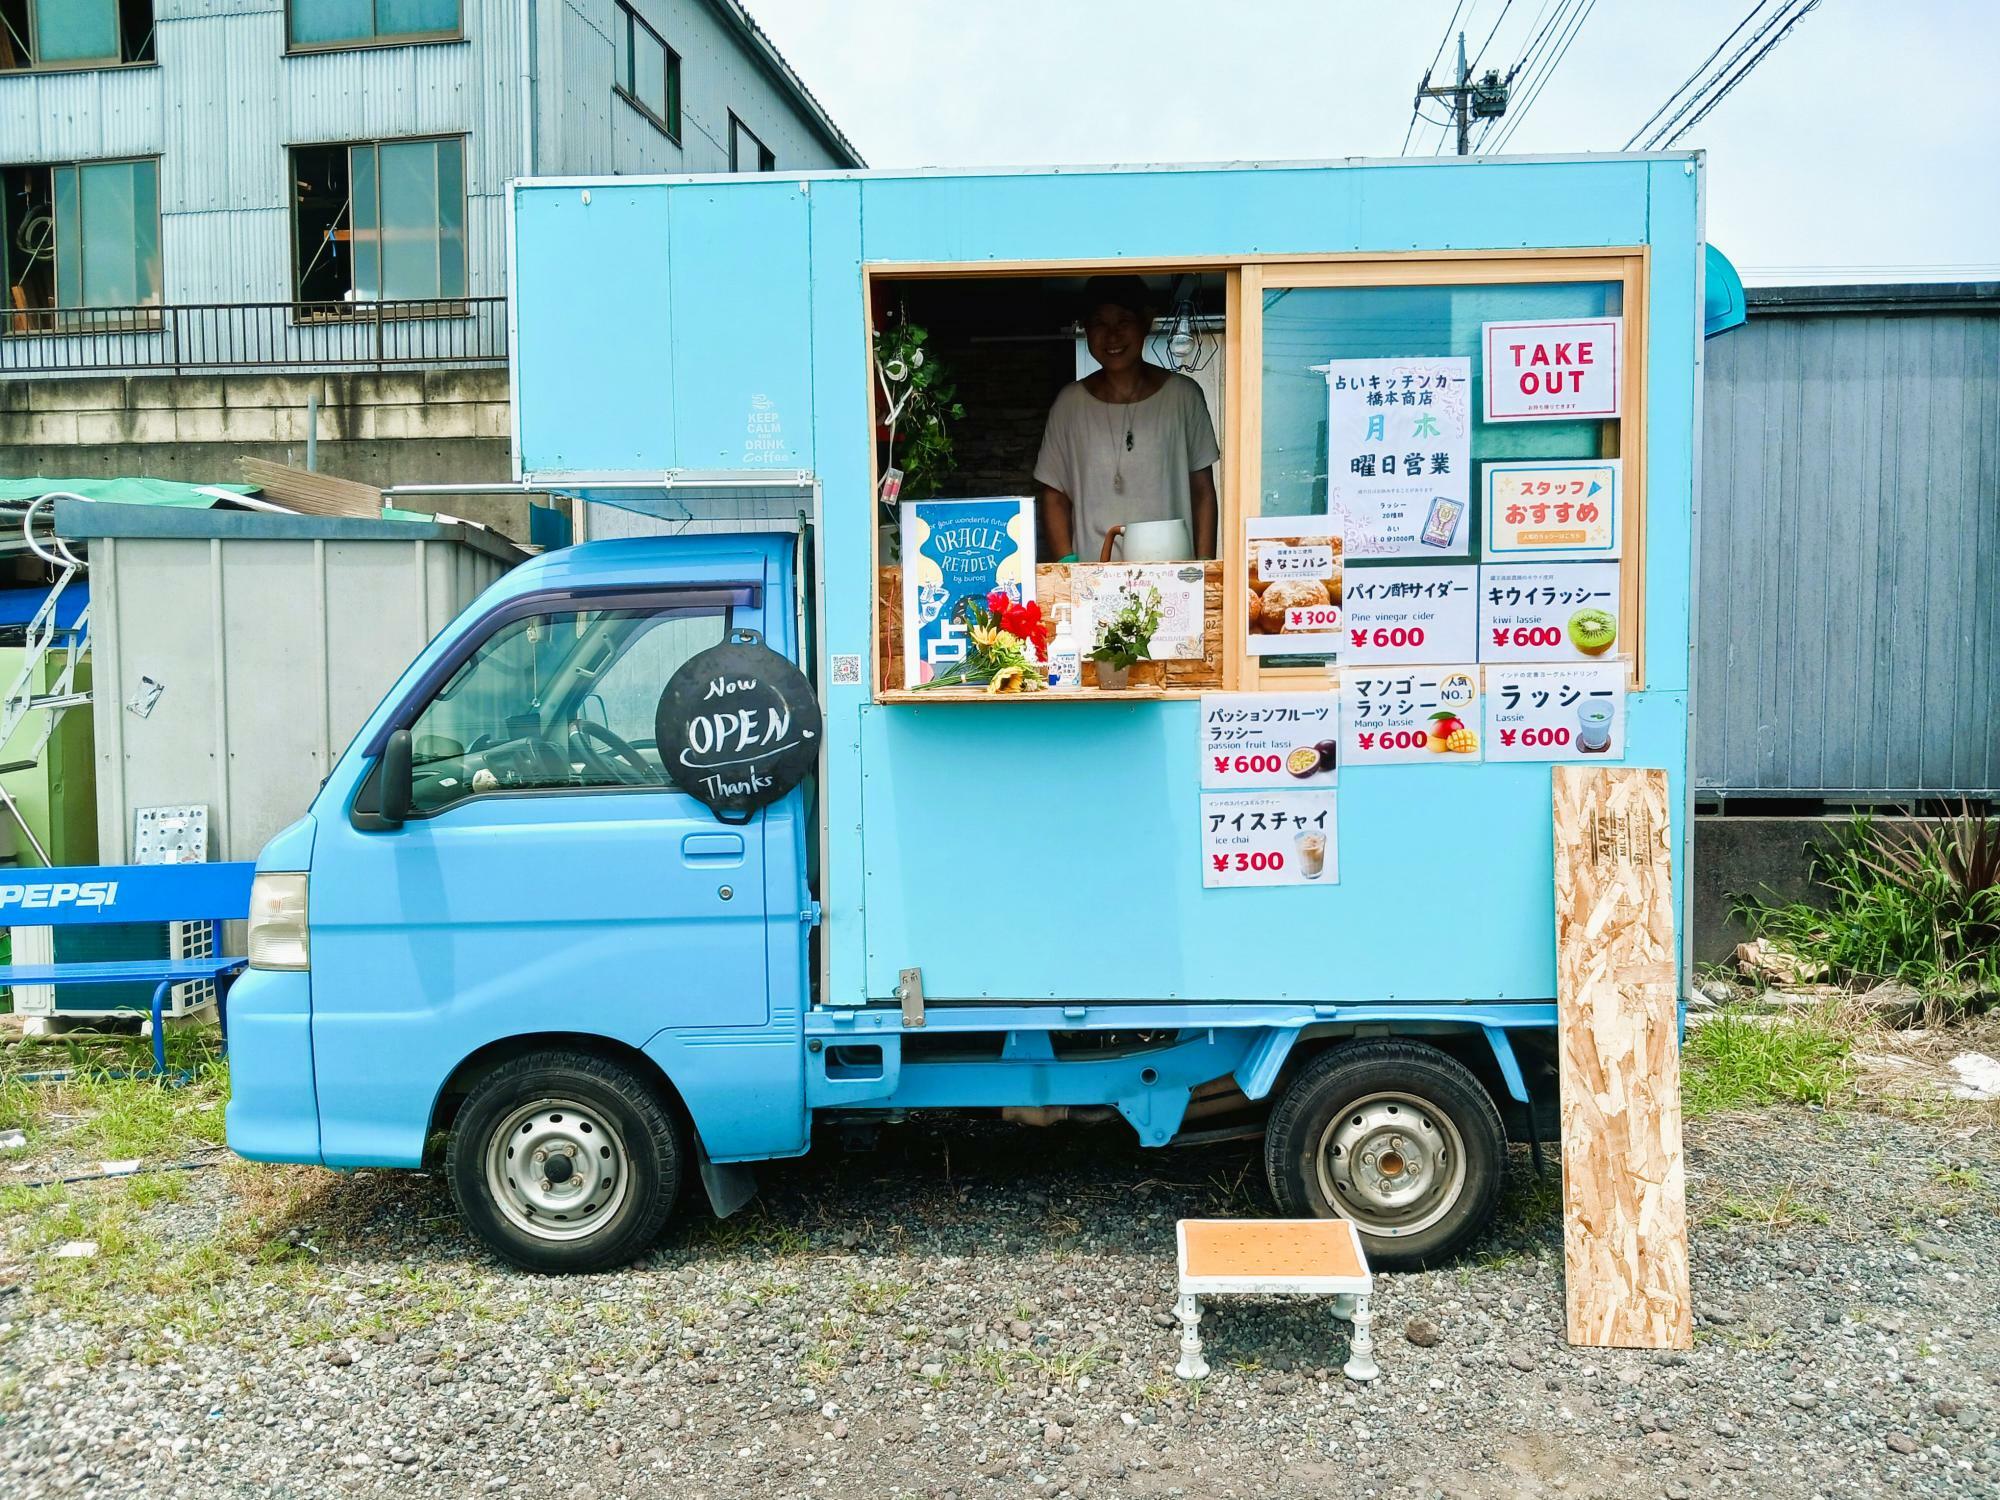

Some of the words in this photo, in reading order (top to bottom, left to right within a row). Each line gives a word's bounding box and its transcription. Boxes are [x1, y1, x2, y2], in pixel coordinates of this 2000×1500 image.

[1509, 342, 1594, 367] TAKE
[1335, 374, 1466, 391] 占いキッチンカー
[1520, 371, 1585, 395] OUT
[1366, 389, 1433, 407] 橋本商店
[747, 412, 779, 423] KEEP
[1365, 414, 1385, 441] 月
[1412, 412, 1441, 439] 木
[746, 423, 781, 433] CALM
[745, 439, 785, 450] DRINK
[1350, 452, 1451, 477] 曜日営業
[1520, 480, 1585, 496] スタッフ
[1505, 501, 1599, 525] おすすめ
[934, 527, 1006, 554] ORACLE
[941, 554, 998, 573] READER
[1264, 557, 1328, 571] きなこパン
[953, 575, 962, 585] by
[1346, 580, 1469, 600] パイン酢サイダー
[1488, 586, 1612, 606] キウイラッシー
[1291, 611, 1337, 625] ¥300
[1351, 613, 1371, 621] Pine
[1375, 613, 1408, 623] vinegar
[1412, 611, 1435, 620] cider
[1492, 615, 1512, 624] kiwi
[1516, 615, 1542, 624] lassie
[1351, 627, 1425, 648] ¥600
[1492, 626, 1562, 647] ¥600
[704, 676, 757, 701] Now
[1355, 675, 1437, 697] マンゴー
[1448, 677, 1468, 687] 人気
[1501, 684, 1614, 710] ラッシー
[1208, 707, 1329, 723] パッションフルーツ
[1357, 699, 1438, 718] ラッシー
[1495, 713, 1525, 722] Lassie
[688, 707, 791, 754] OPEN
[1354, 719, 1384, 729] Mango
[1388, 718, 1414, 727] lassie
[1211, 726, 1263, 741] ラッシー
[1358, 730, 1428, 750] ¥600
[1500, 727, 1570, 747] ¥600
[1208, 740, 1241, 751] passion
[1245, 740, 1267, 749] fruit
[1214, 754, 1282, 773] ¥600
[698, 765, 774, 799] Thanks
[1208, 810, 1328, 833] アイスチャイ
[1215, 835, 1228, 845] ice
[1231, 835, 1250, 844] chai
[1212, 852, 1285, 872] ¥300
[0, 881, 118, 909] PEPSI
